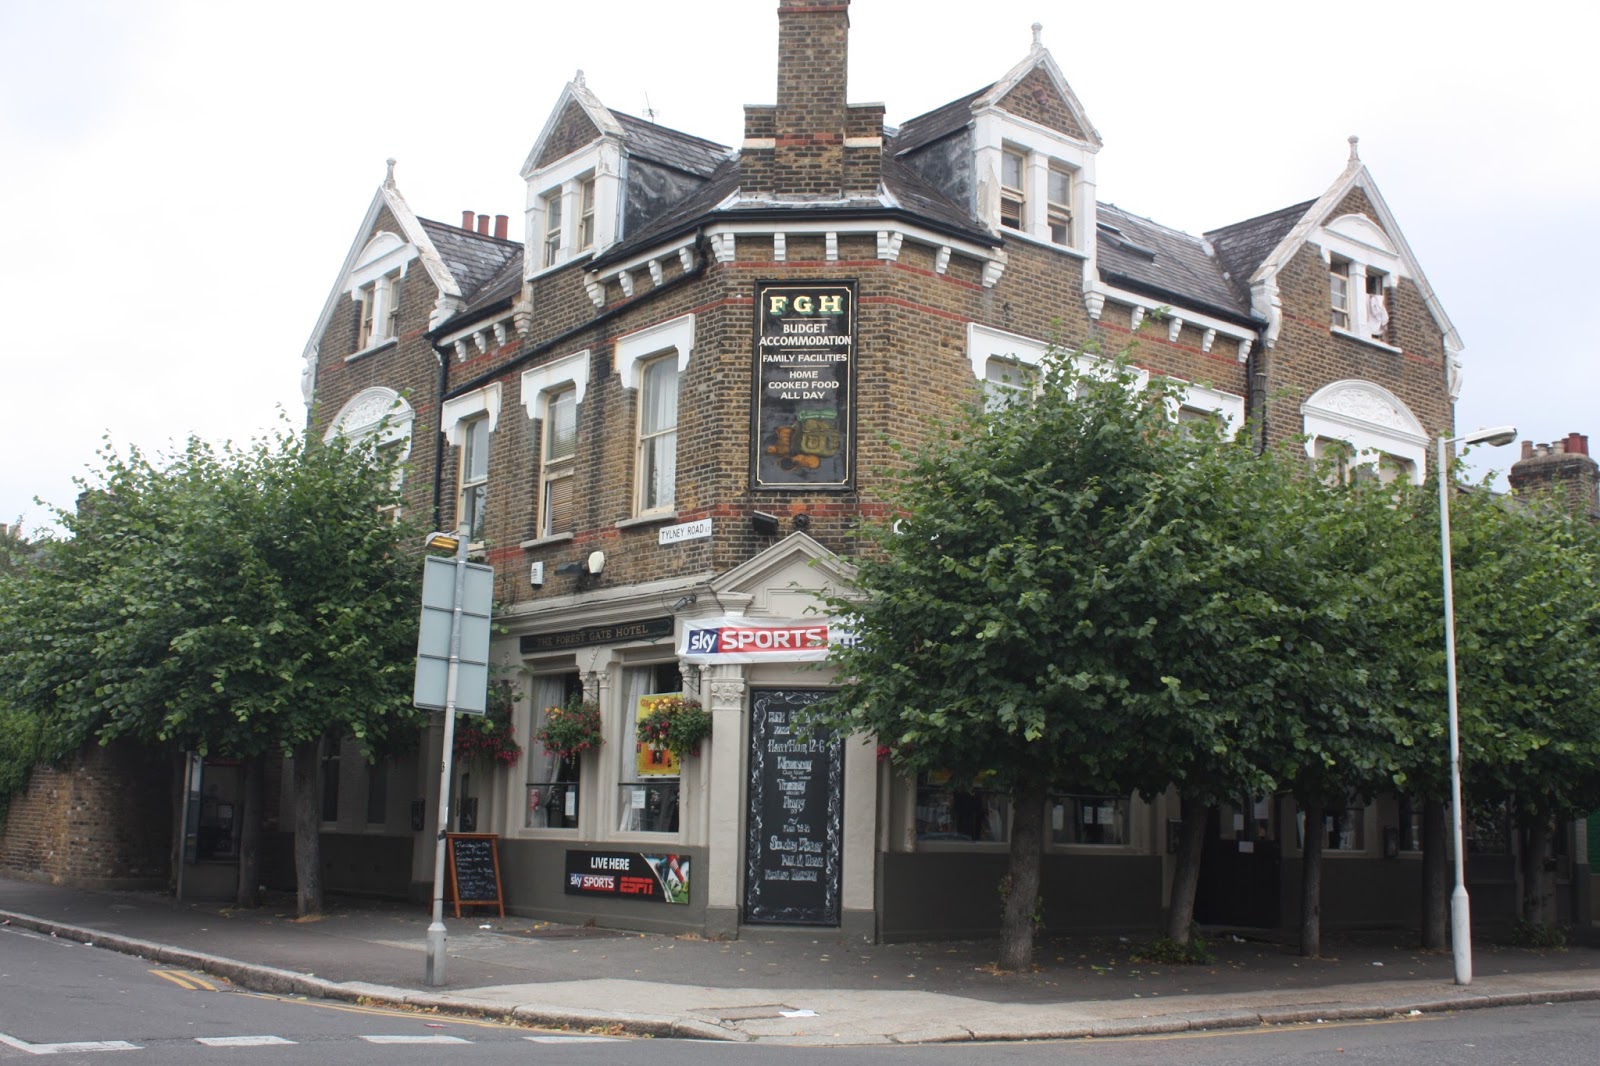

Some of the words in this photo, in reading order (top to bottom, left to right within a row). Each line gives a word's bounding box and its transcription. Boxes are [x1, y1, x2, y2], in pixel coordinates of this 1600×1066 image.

[770, 296, 843, 315] FGH
[783, 324, 828, 334] BUDGET
[759, 336, 851, 346] ACCOMMODATION
[762, 354, 795, 362] FAMILY
[798, 354, 847, 362] FACILITIES
[661, 528, 685, 540] TYLNEY
[687, 524, 704, 536] ROAD
[537, 637, 553, 646] THE
[556, 633, 586, 645] FOREST
[589, 629, 612, 641] GATE
[616, 624, 648, 637] HOTEL
[691, 631, 718, 653] sky
[722, 628, 822, 650] SPORTS
[809, 739, 825, 753] 12-6
[591, 857, 608, 869] LIVE
[609, 858, 630, 870] HERE
[570, 875, 581, 888] sky
[583, 876, 614, 888] SPORTS
[620, 876, 653, 894] ESPN
